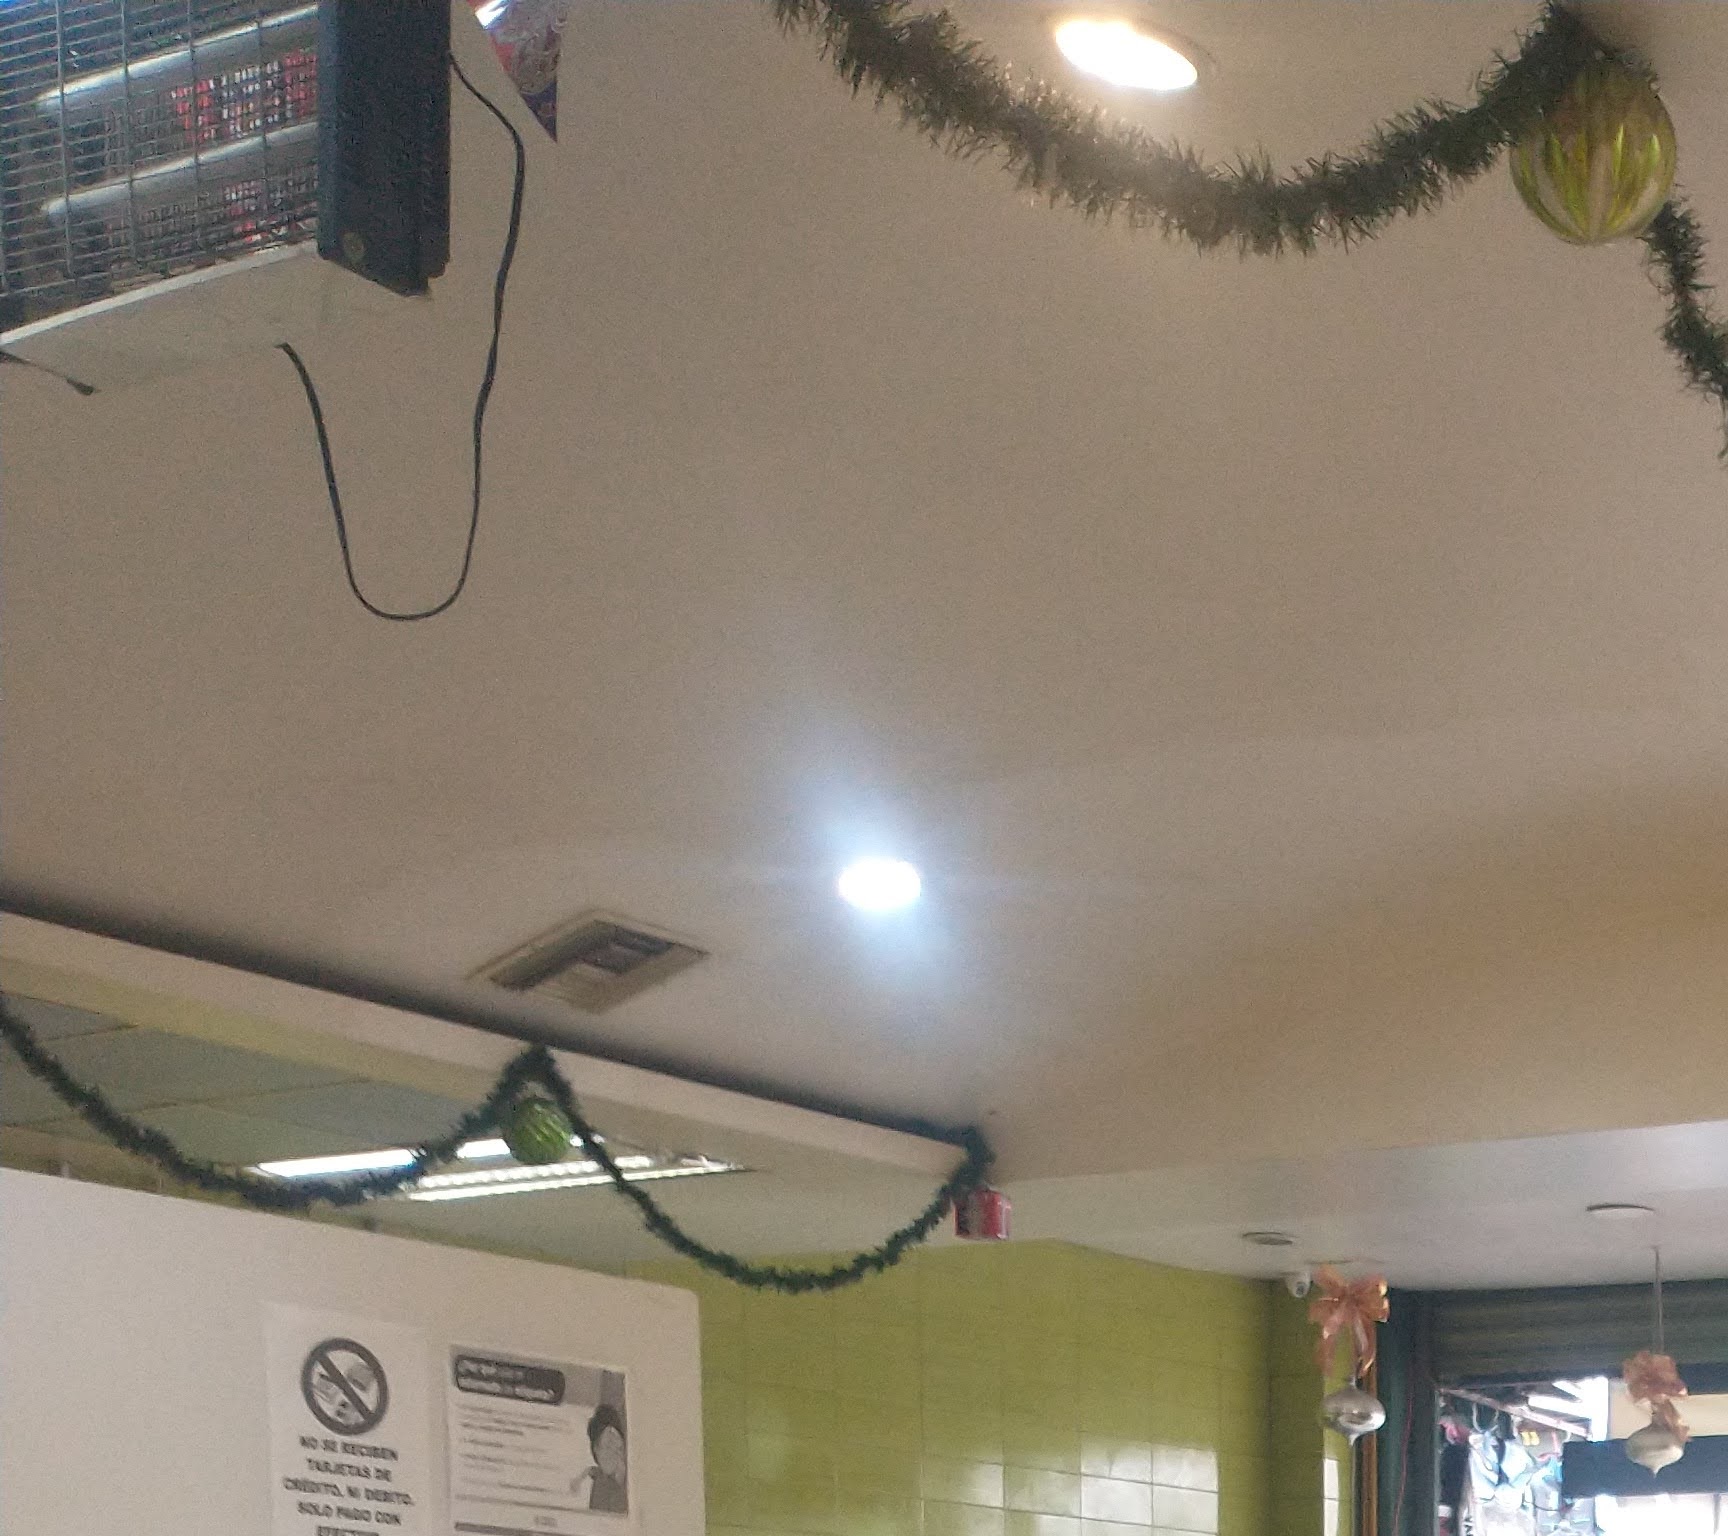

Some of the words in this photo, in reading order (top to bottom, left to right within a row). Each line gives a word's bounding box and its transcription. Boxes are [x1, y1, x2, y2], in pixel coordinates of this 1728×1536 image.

[298, 1435, 318, 1450] NO
[373, 1466, 392, 1482] DE
[374, 1510, 402, 1526] CON
